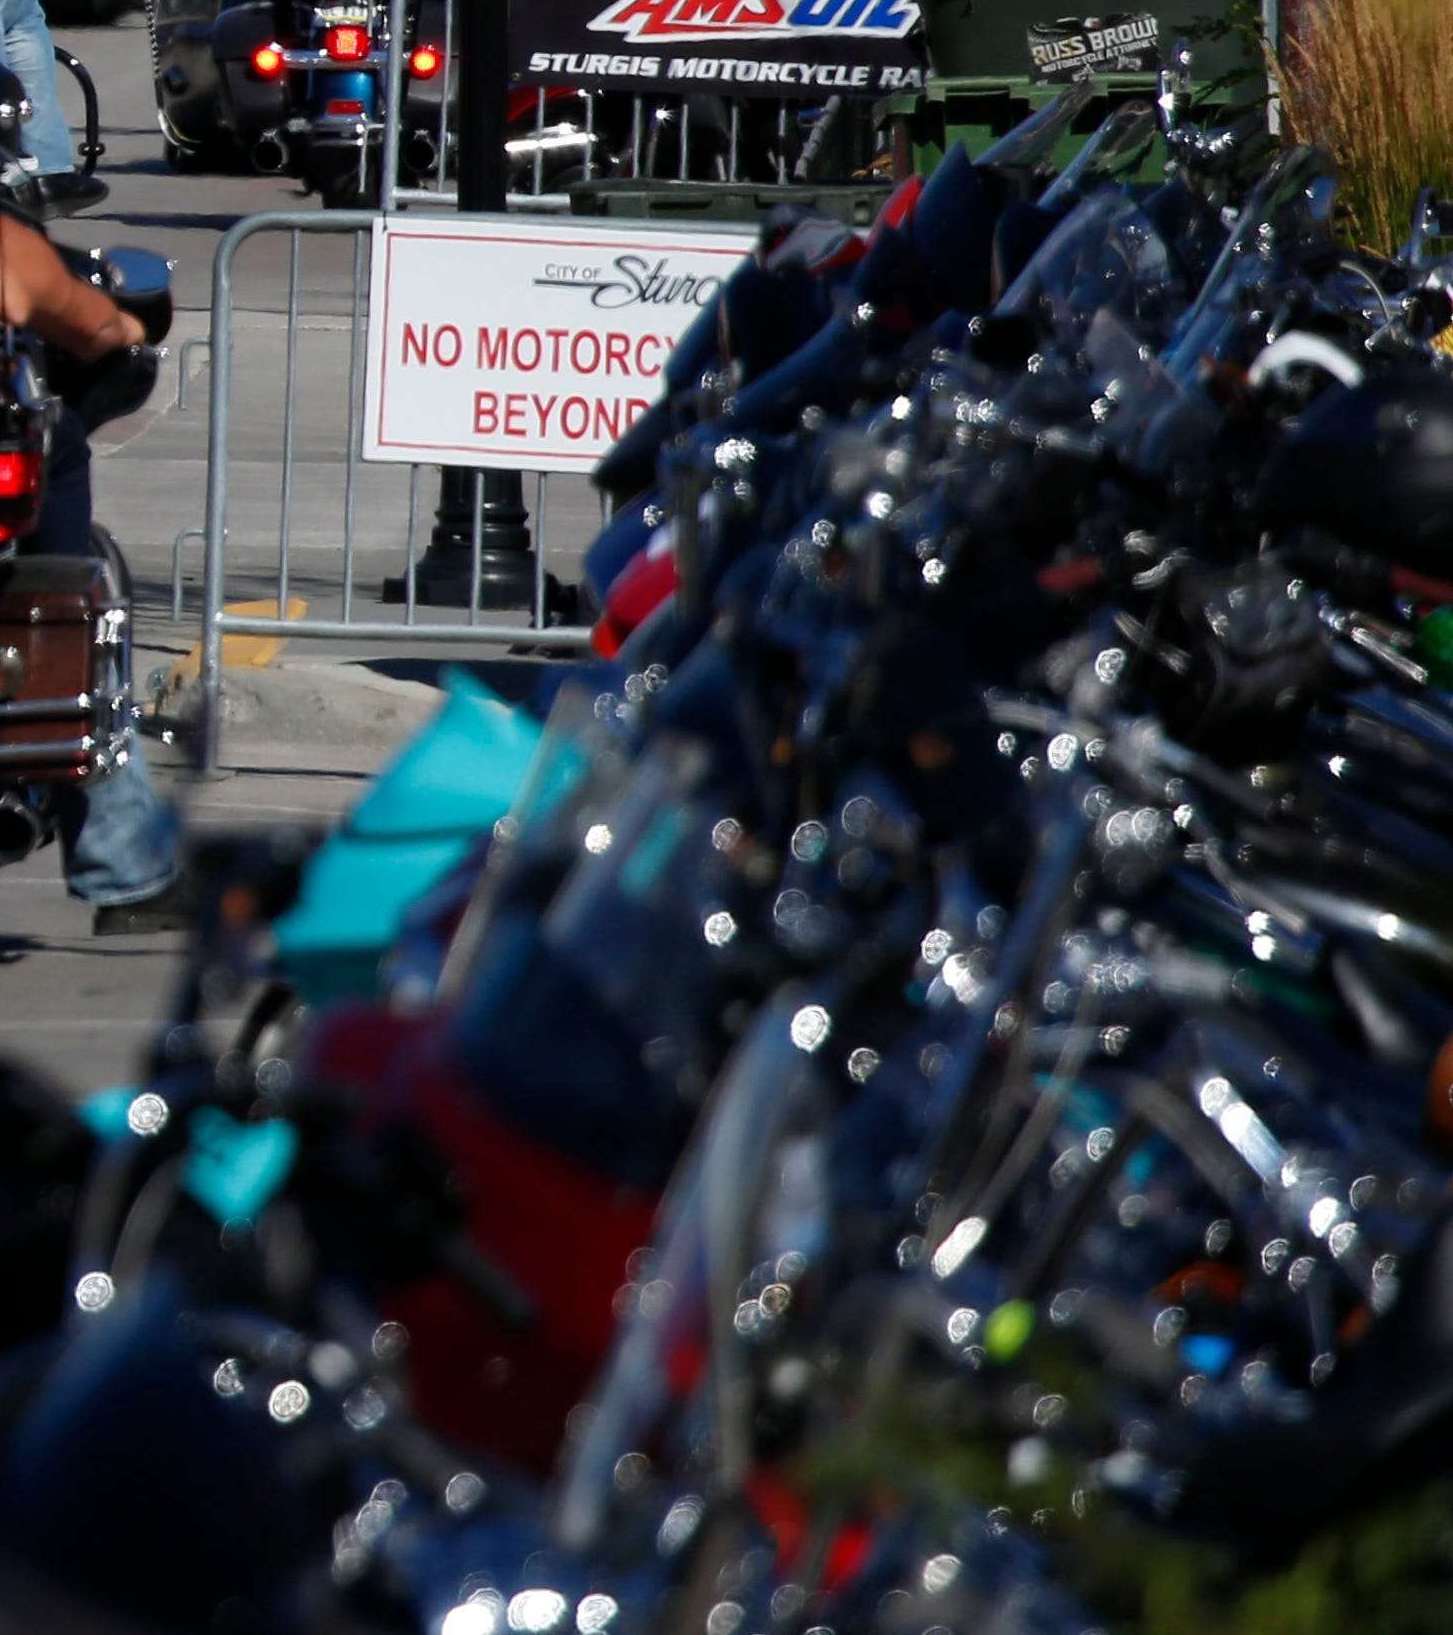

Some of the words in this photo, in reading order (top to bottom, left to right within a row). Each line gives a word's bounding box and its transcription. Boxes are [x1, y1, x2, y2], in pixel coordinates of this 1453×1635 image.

[1031, 36, 1086, 66] RUSS
[529, 51, 662, 78] STURGIS
[667, 56, 868, 87] MOTORCYCLE
[544, 263, 577, 279] CITY
[581, 265, 601, 279] OF
[401, 322, 462, 366] NO
